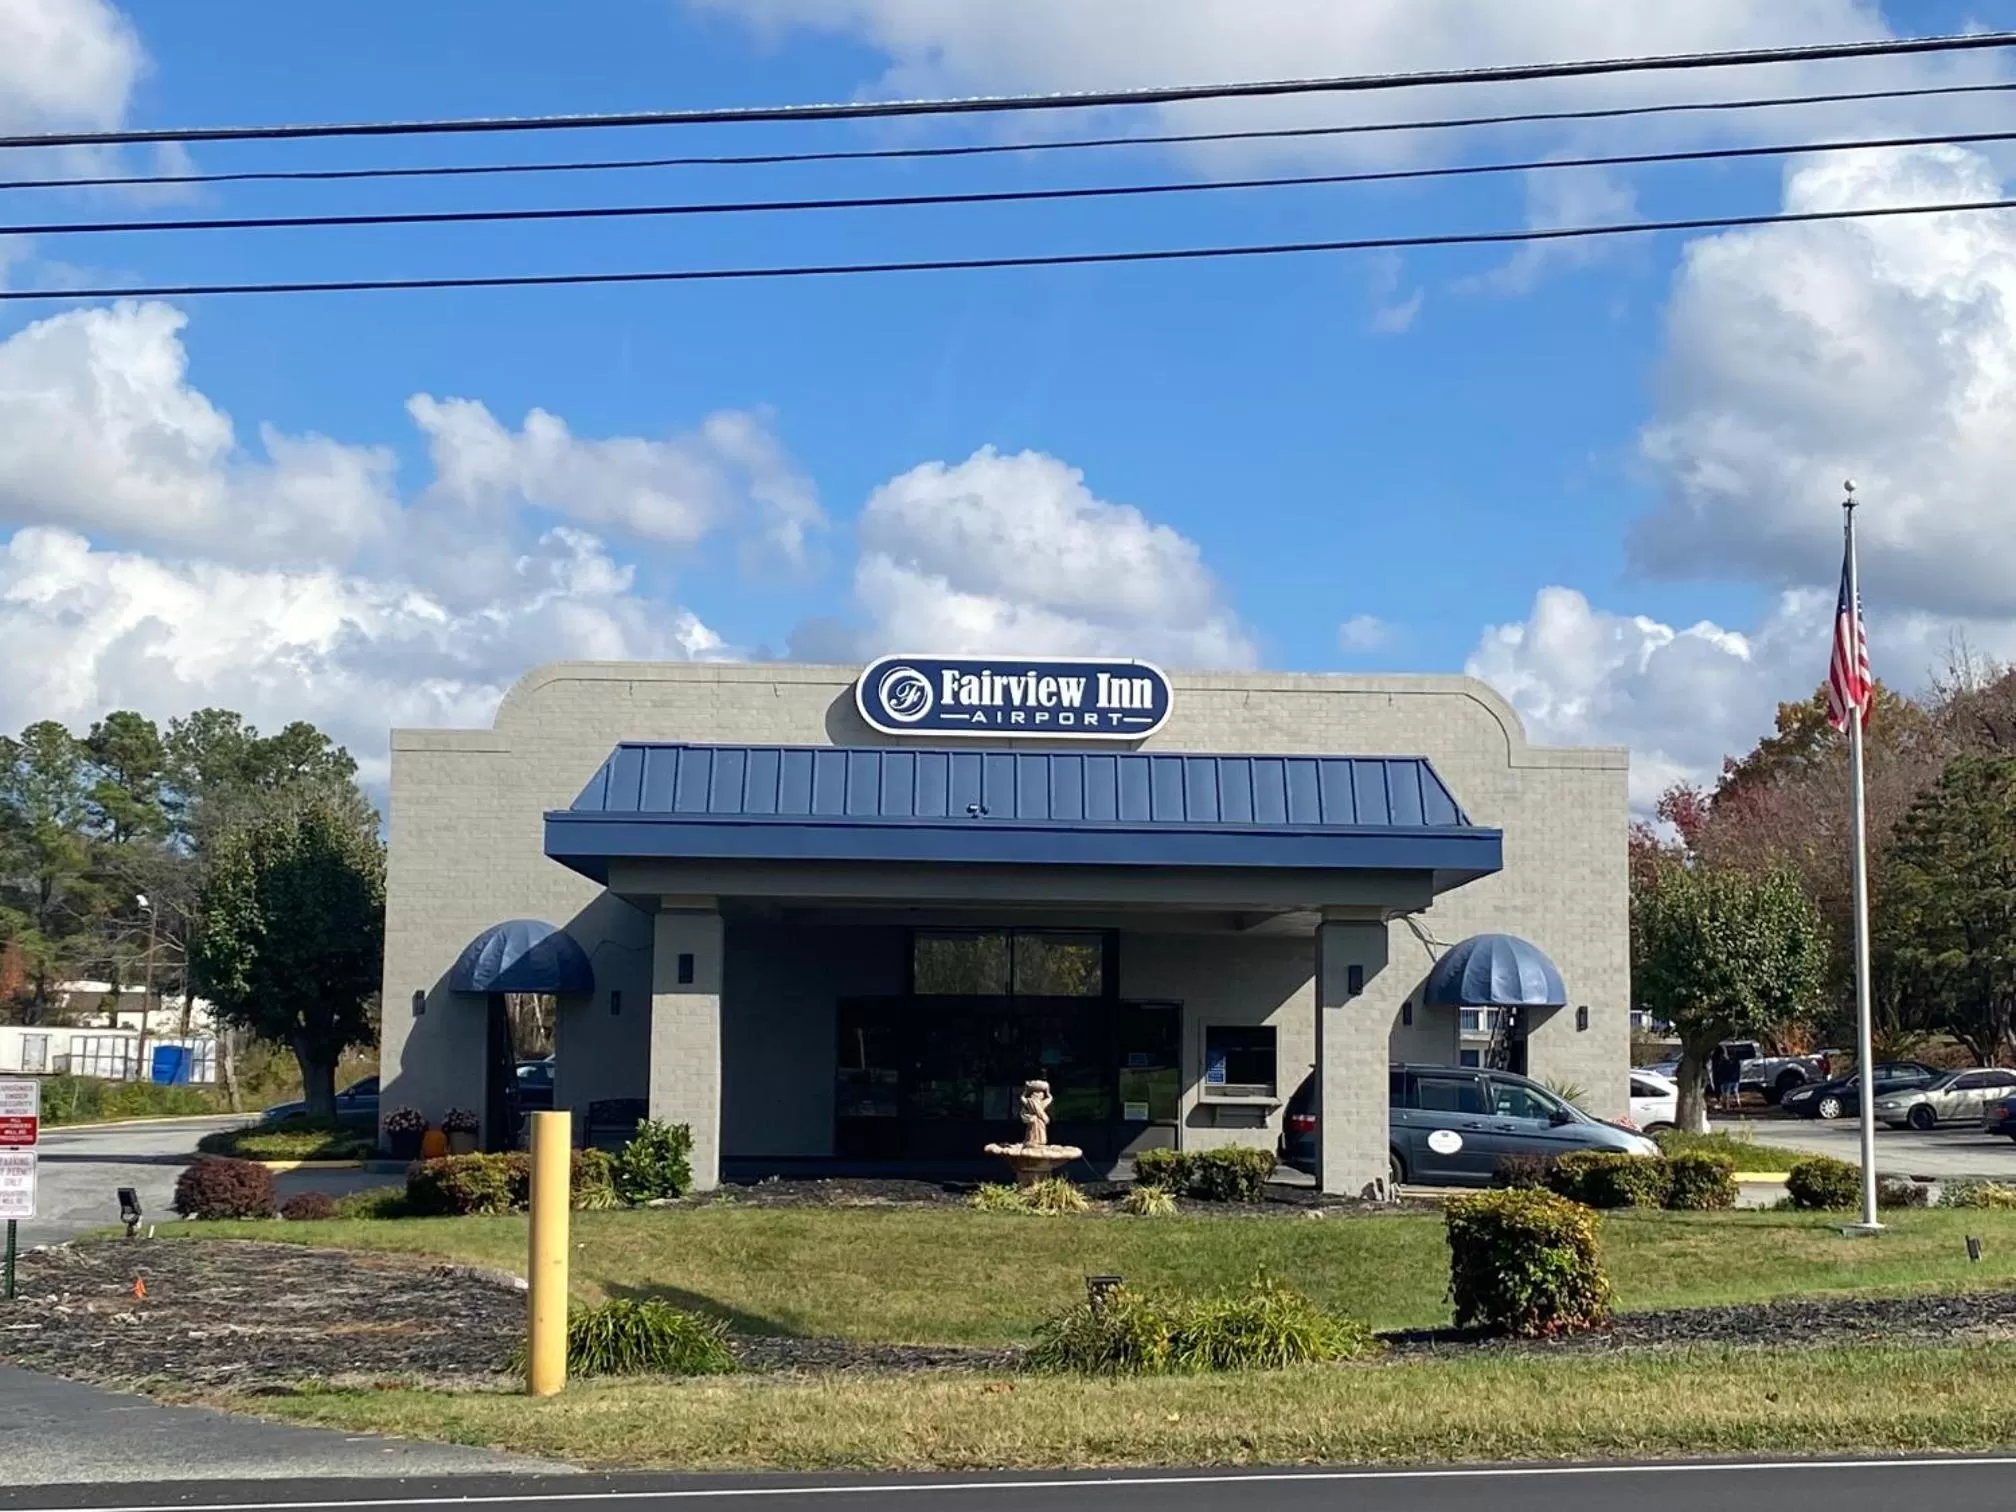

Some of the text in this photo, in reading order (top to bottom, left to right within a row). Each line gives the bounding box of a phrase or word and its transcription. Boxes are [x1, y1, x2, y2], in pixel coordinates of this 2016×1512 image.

[940, 669, 1153, 709] Fairview Inn
[970, 710, 1124, 726] AIRPORT
